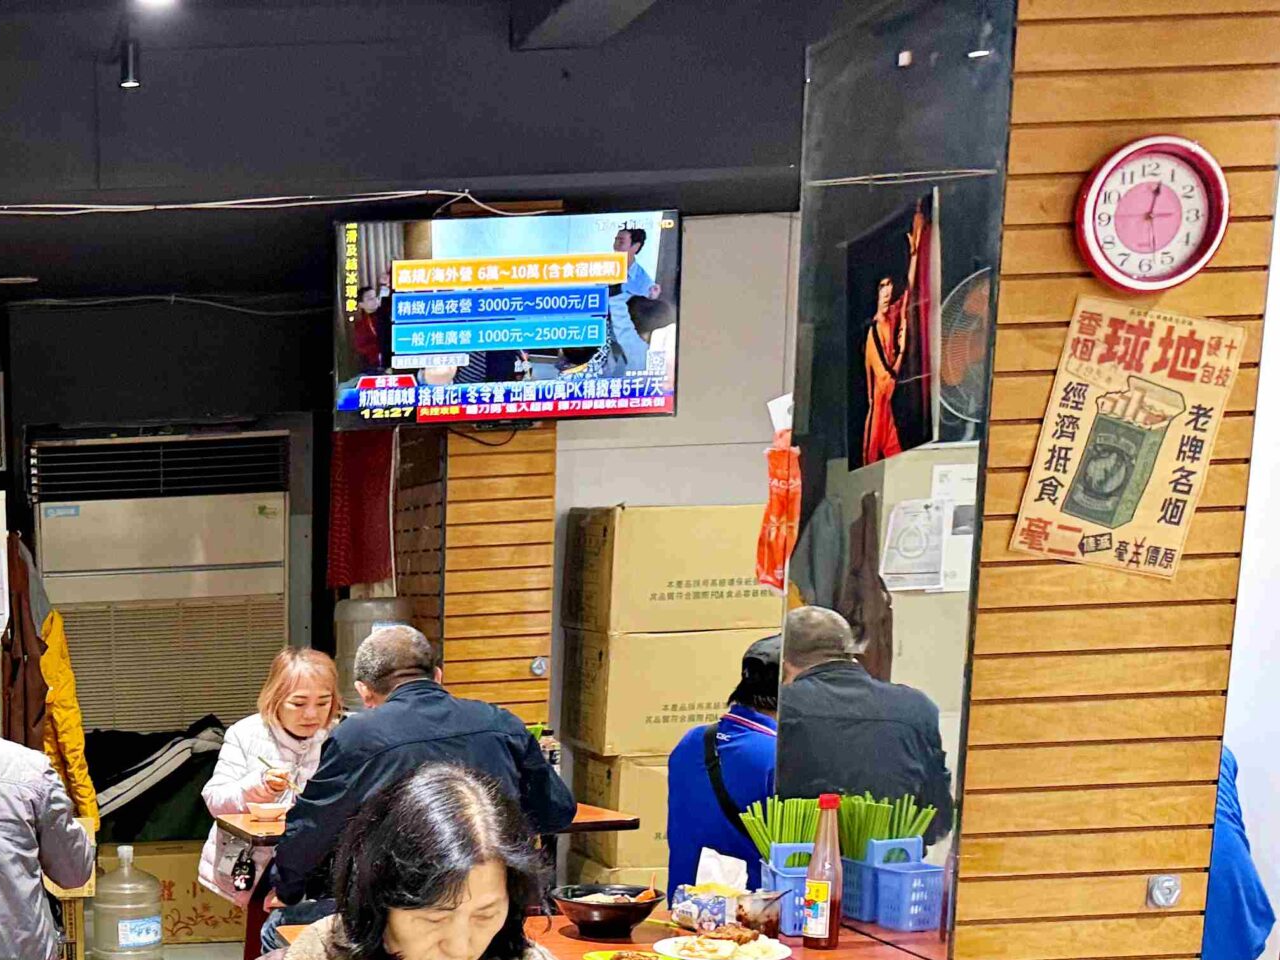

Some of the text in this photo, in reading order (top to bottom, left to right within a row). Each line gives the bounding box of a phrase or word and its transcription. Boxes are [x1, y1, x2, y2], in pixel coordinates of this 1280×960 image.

[1141, 162, 1160, 178] 12
[1170, 169, 1176, 182] 1
[1121, 171, 1135, 185] 11
[1103, 190, 1120, 204] 10
[1182, 185, 1195, 199] 2
[1097, 213, 1111, 226] 9
[1185, 209, 1200, 222] 3
[1102, 234, 1115, 249] 8
[1118, 253, 1130, 267] 7
[1138, 258, 1152, 272] 6
[1160, 251, 1174, 265] 5
[397, 298, 473, 316] 精緻/過夜營
[397, 329, 472, 347] 一般/推廣營
[375, 376, 399, 387] 台北
[466, 384, 506, 404] 冬令營
[360, 406, 415, 419] 12:27
[1033, 380, 1089, 506] 經濟抵食
